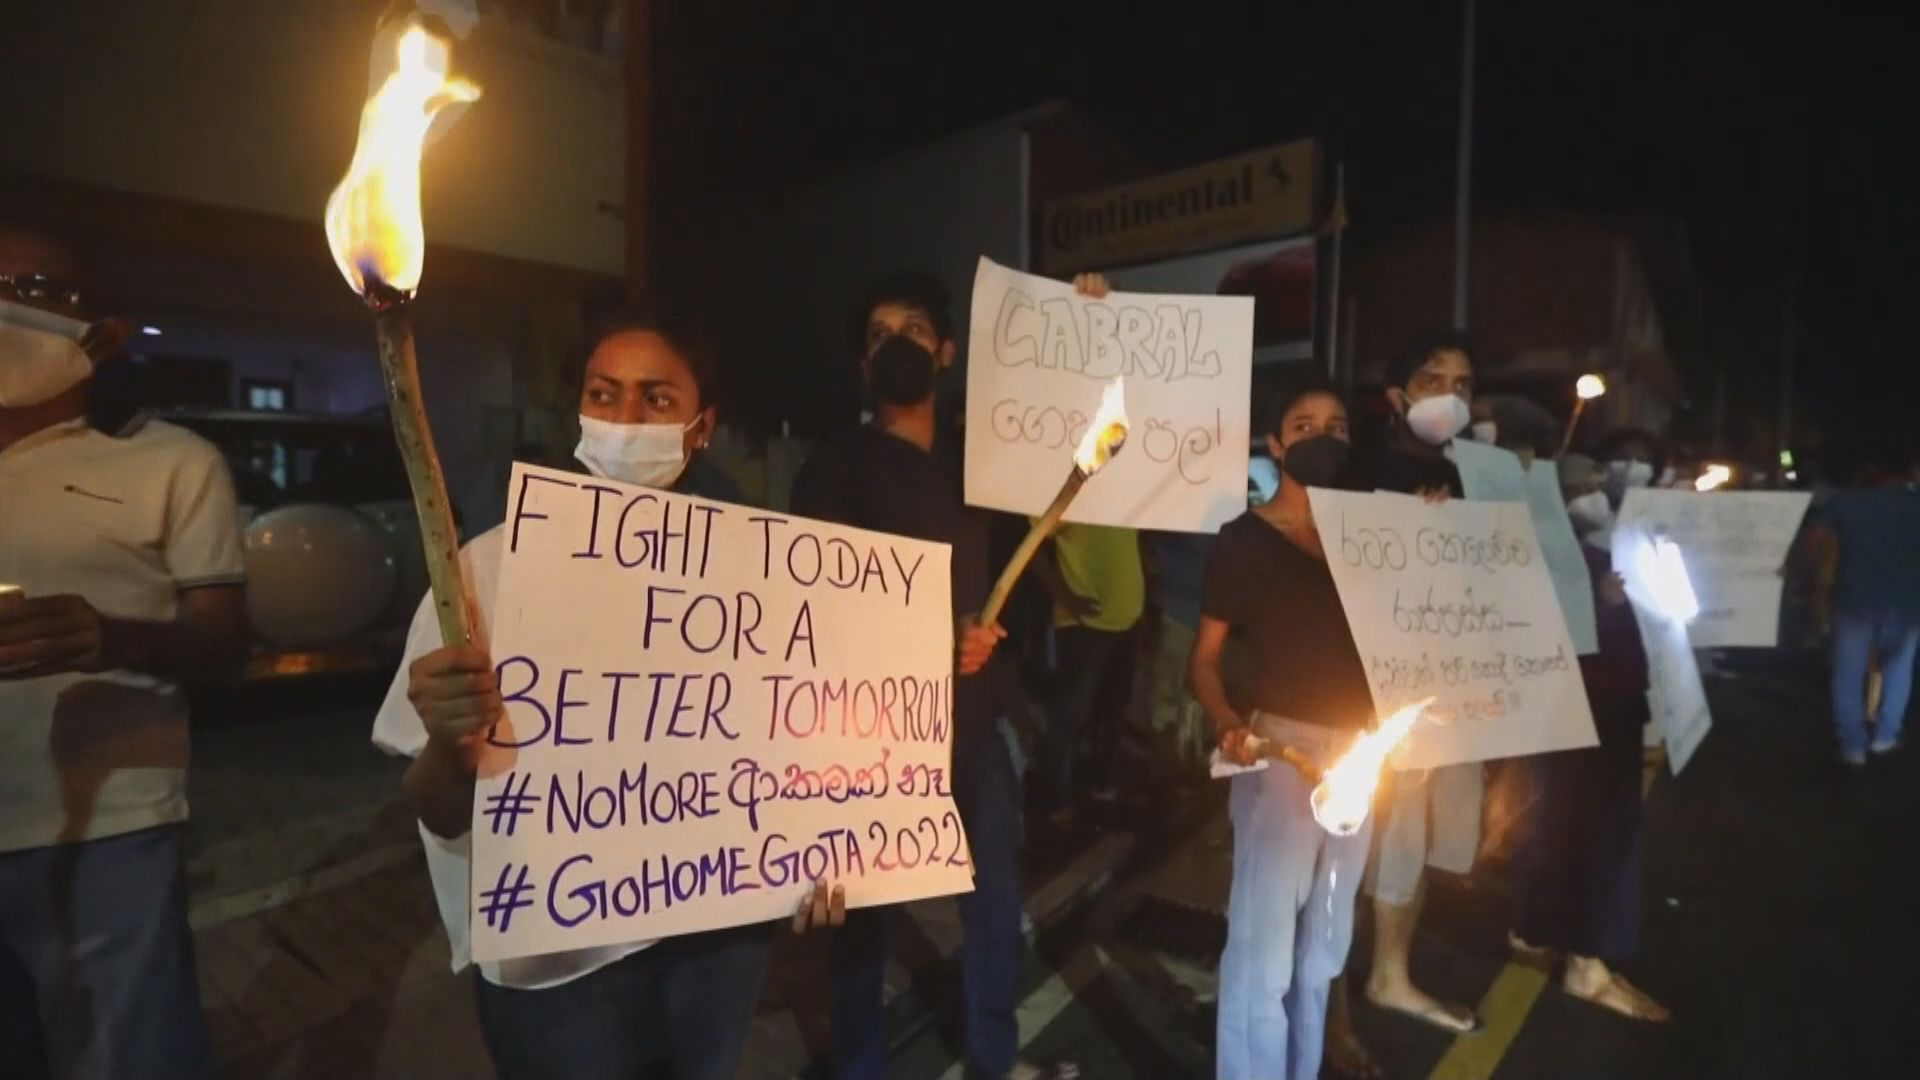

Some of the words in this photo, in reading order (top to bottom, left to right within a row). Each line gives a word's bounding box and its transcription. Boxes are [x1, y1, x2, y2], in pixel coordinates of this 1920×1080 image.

[993, 288, 1222, 382] CABRAL
[510, 473, 724, 579] FIGHT
[748, 517, 925, 606] TODAY
[642, 585, 767, 661] FOR
[784, 600, 817, 668] A
[487, 655, 740, 749] BETTER
[762, 672, 952, 745] TOMORROW
